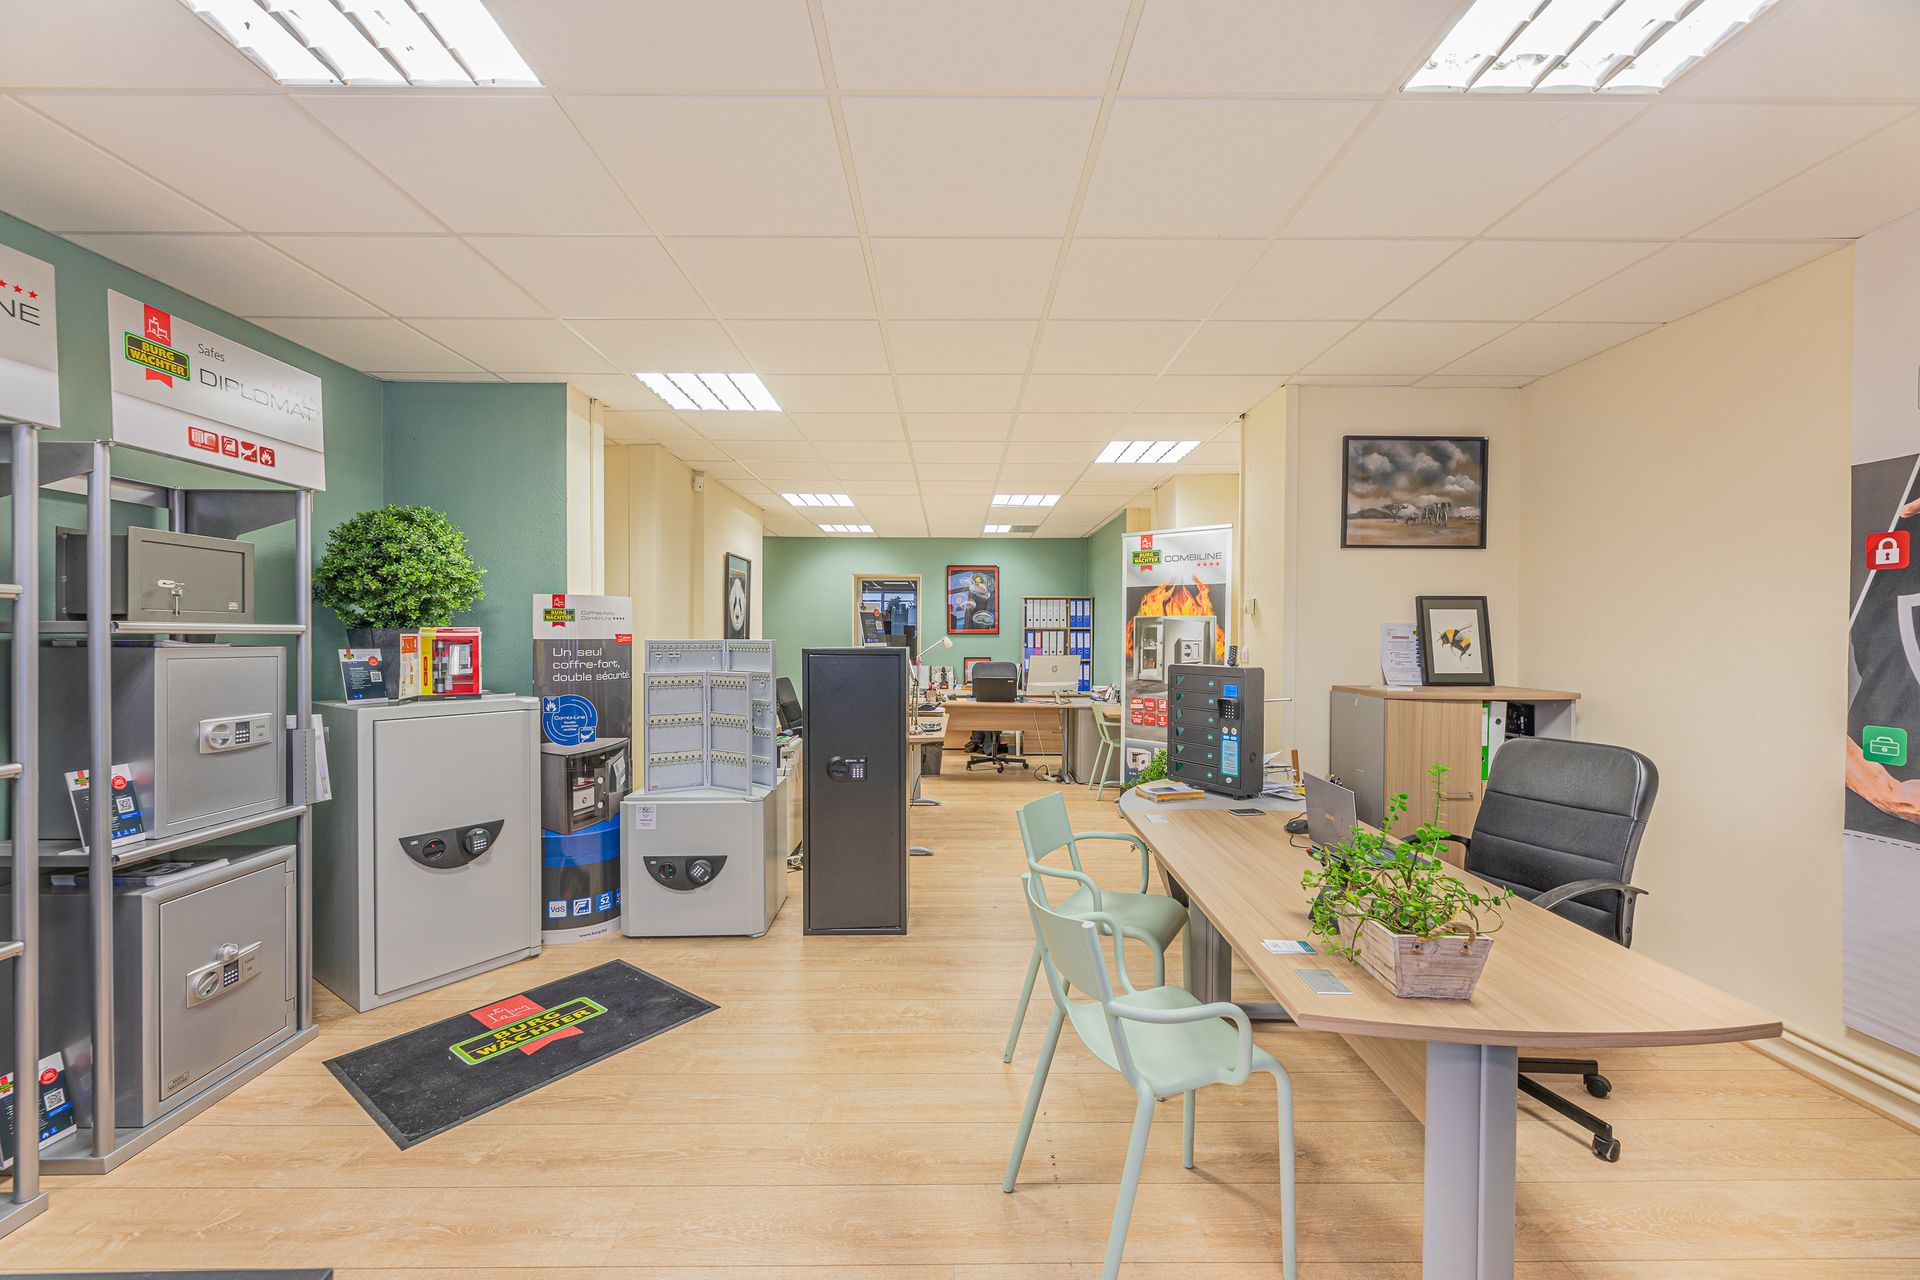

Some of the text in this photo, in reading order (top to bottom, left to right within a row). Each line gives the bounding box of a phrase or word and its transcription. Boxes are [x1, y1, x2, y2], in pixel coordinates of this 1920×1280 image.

[141, 341, 175, 361] BURG
[198, 343, 225, 363] Safes
[129, 347, 186, 376] WÄCHTER
[200, 368, 316, 421] DIPLOMAT
[1164, 552, 1222, 562] COMBILINE
[552, 647, 602, 657] Un seul
[552, 659, 621, 669] coffre-fort,
[552, 673, 592, 682] double
[550, 905, 566, 913] VdS
[476, 1009, 593, 1056] WÄCHTER
[492, 1011, 562, 1040] BURG
